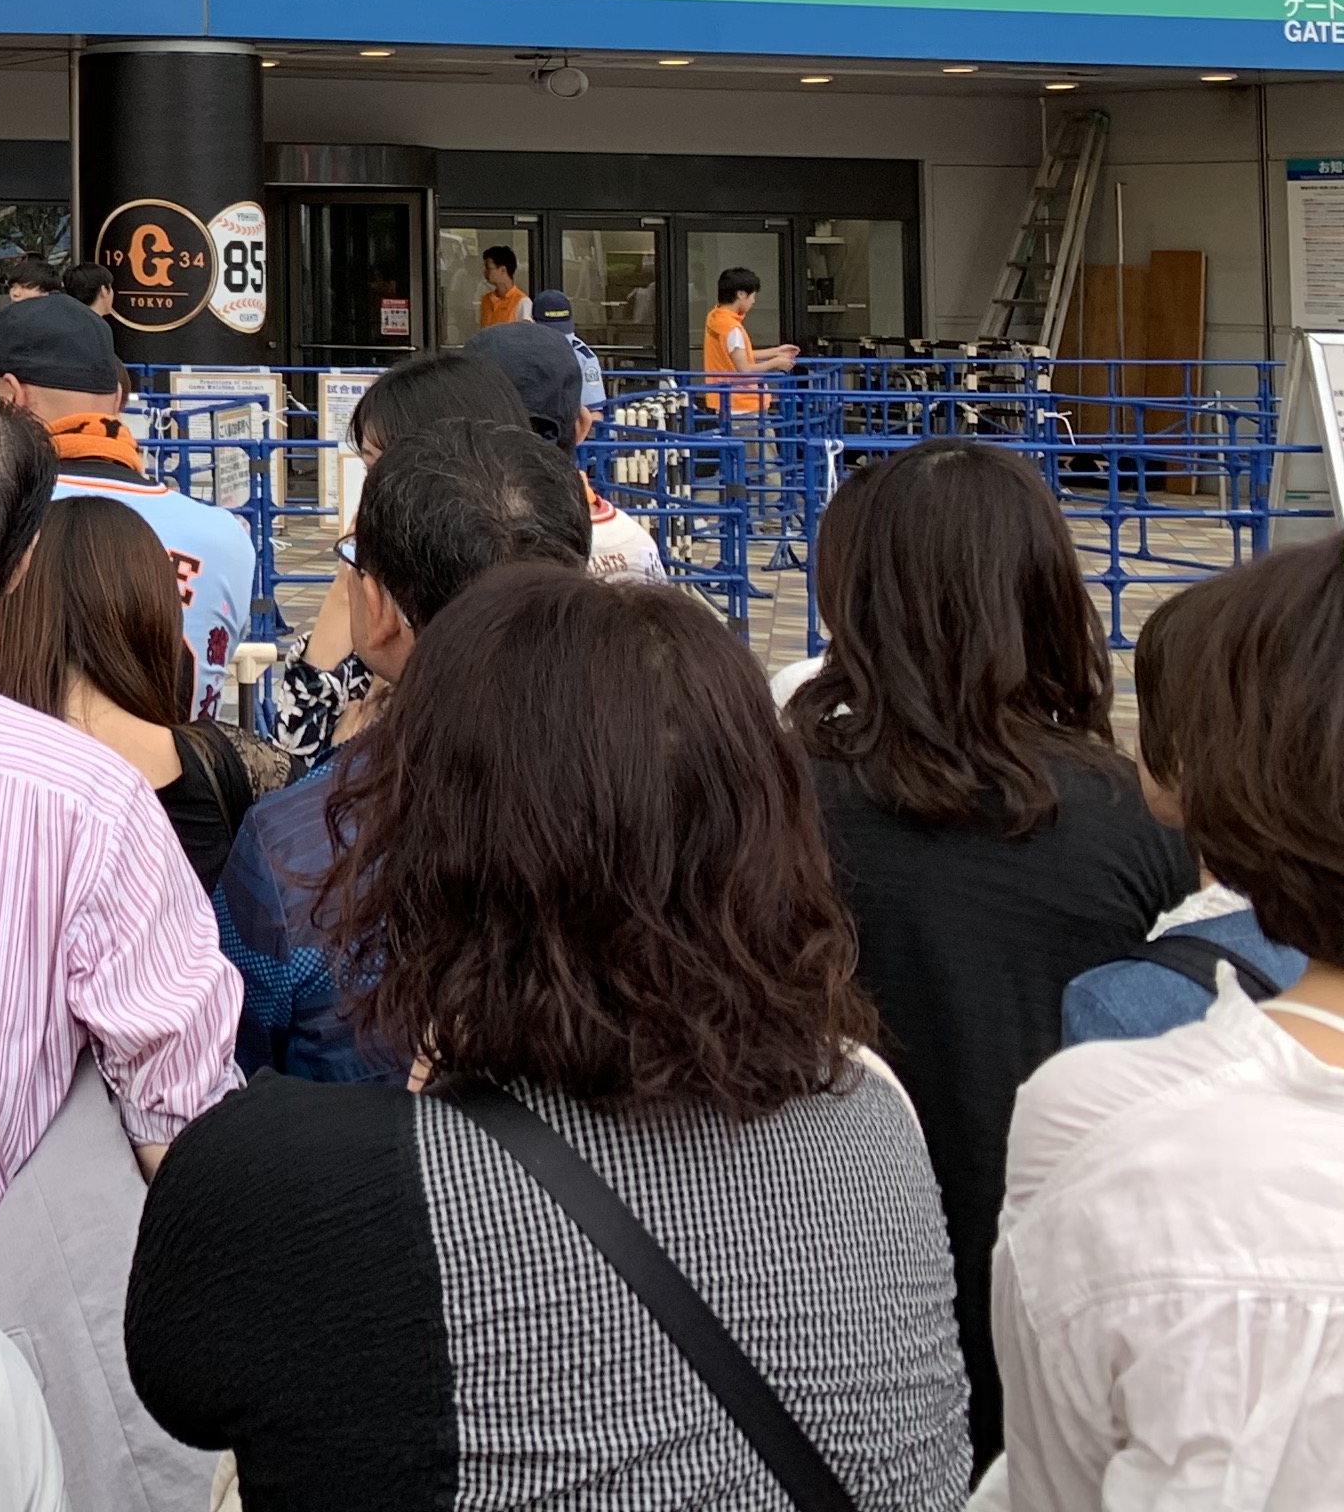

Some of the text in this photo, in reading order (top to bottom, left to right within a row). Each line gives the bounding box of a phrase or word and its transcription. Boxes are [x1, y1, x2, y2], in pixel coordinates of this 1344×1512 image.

[1284, 20, 1344, 44] GATE
[105, 224, 205, 286] 19 G 34
[130, 297, 173, 308] TOKYO
